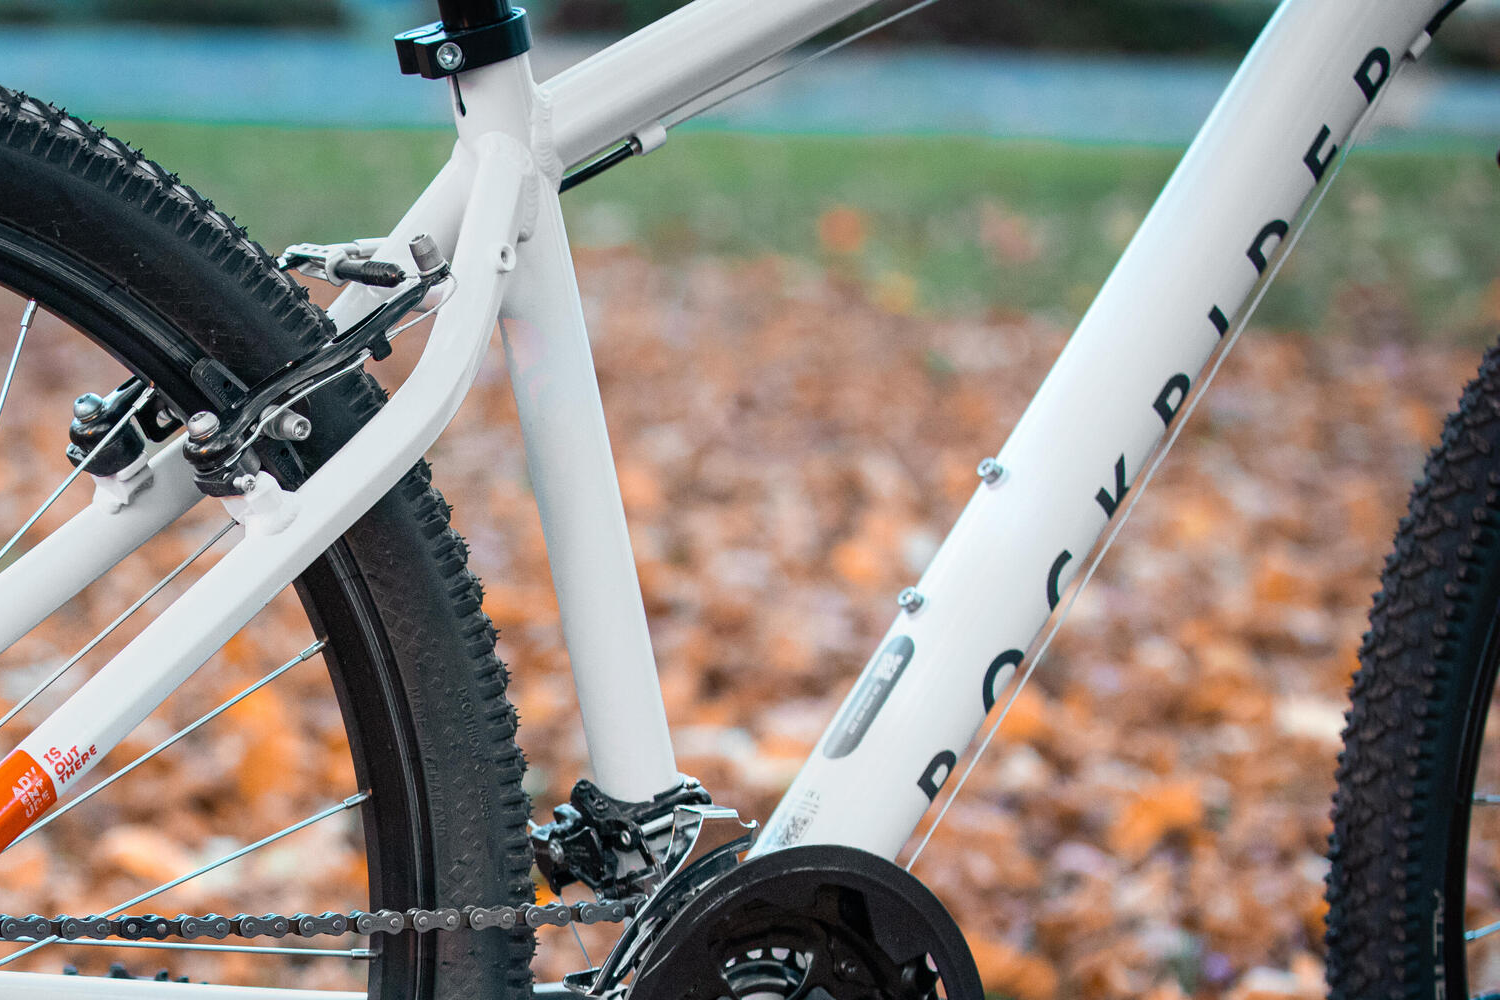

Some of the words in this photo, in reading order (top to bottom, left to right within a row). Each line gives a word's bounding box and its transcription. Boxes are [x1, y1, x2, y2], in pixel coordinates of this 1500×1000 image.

[43, 746, 62, 766] IS
[54, 745, 80, 776] OUT
[58, 744, 98, 785] THERE
